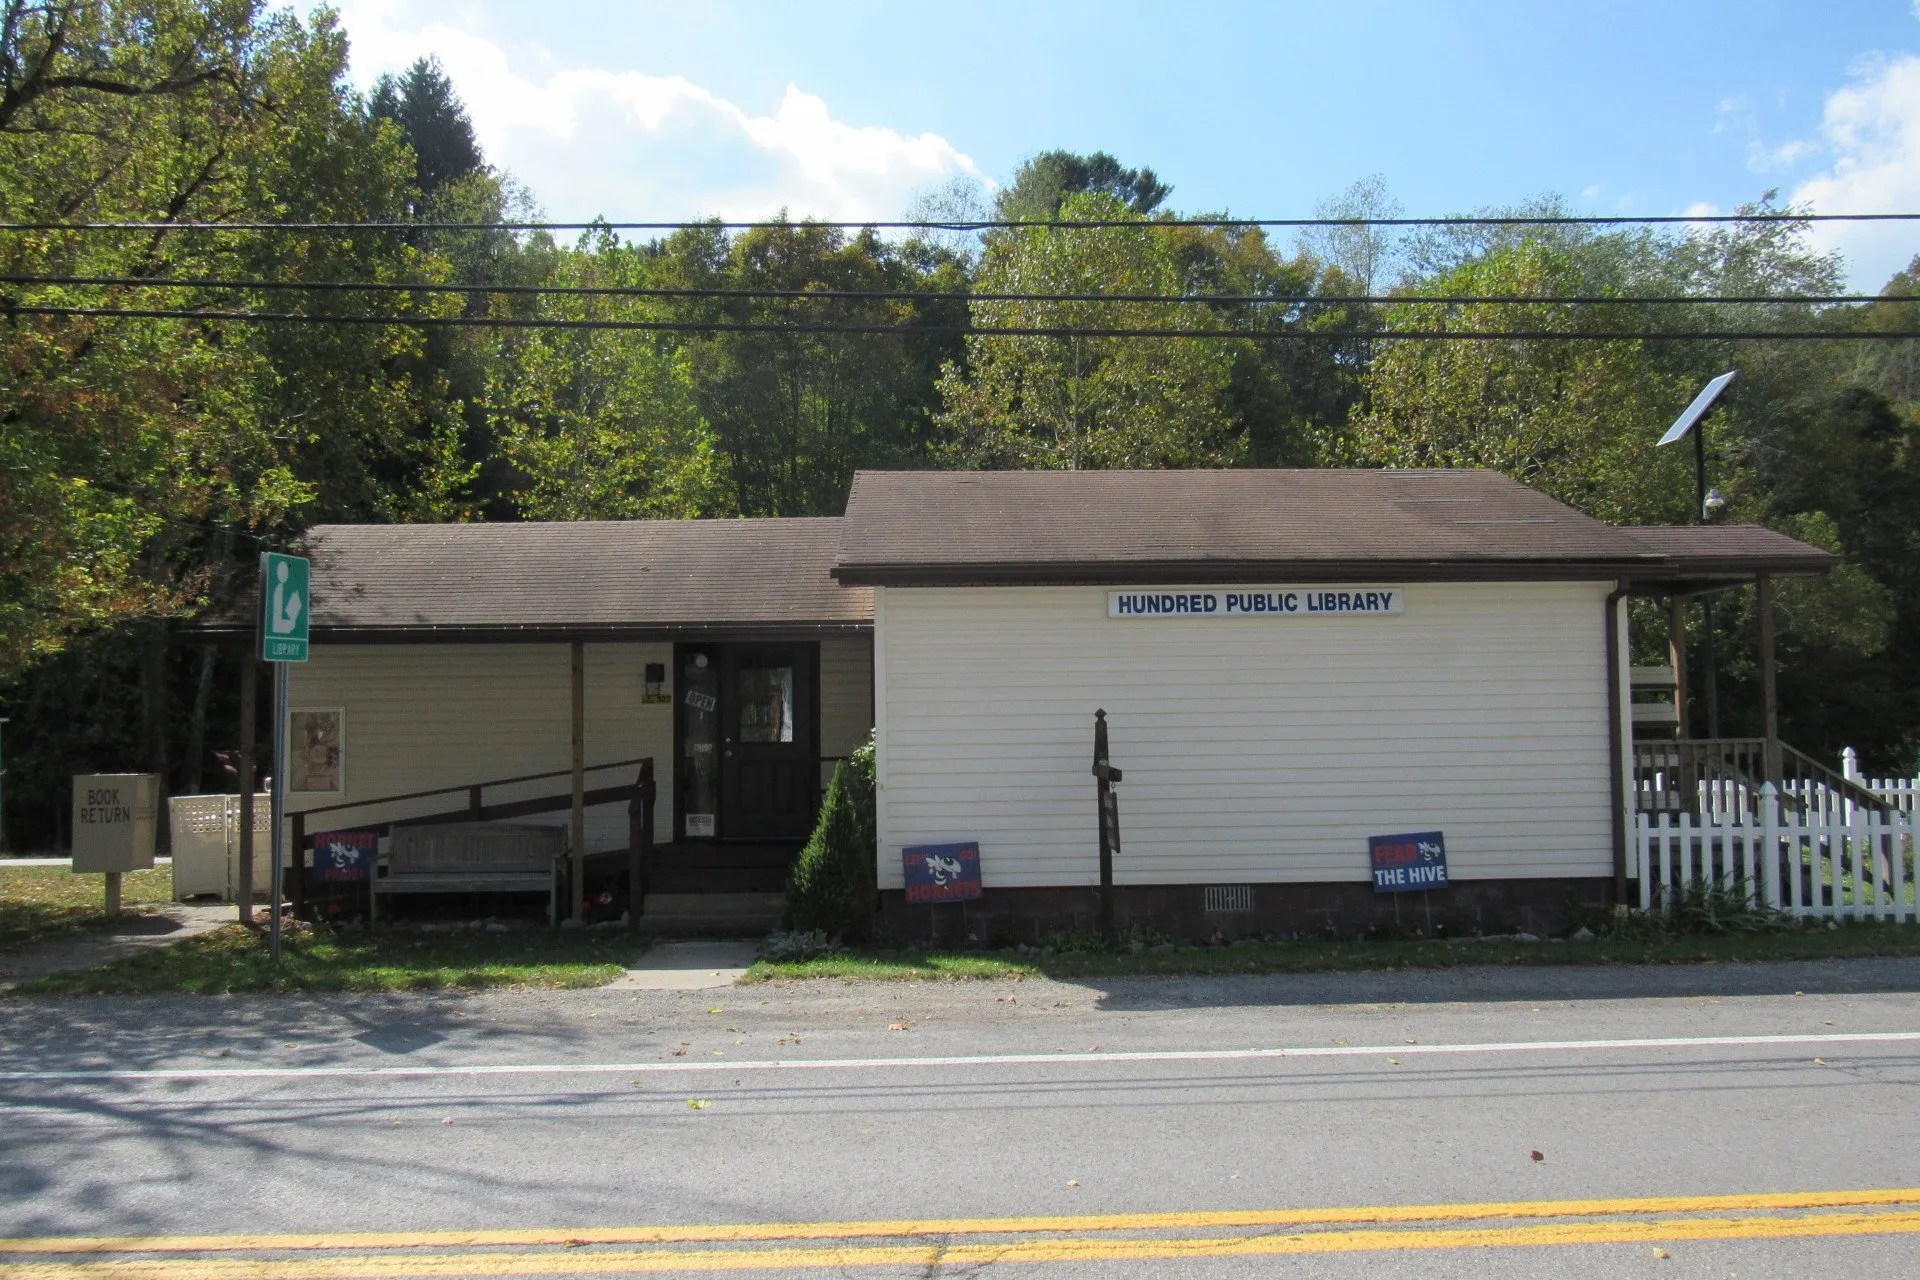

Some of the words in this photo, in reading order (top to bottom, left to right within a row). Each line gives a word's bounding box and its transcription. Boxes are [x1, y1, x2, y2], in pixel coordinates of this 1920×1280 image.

[1118, 594, 1217, 614] HUNDRED
[1226, 593, 1298, 612] PUBLIC
[1307, 592, 1392, 611] LIBRARY
[272, 643, 300, 656] LIBRARY
[687, 691, 715, 710] OPEN
[88, 789, 119, 805] BOOK
[81, 807, 131, 823] RETURN
[1375, 843, 1417, 863] FEAR
[1375, 869, 1406, 886] THE
[1408, 865, 1446, 883] HIVE
[907, 880, 980, 900] HORNETS
